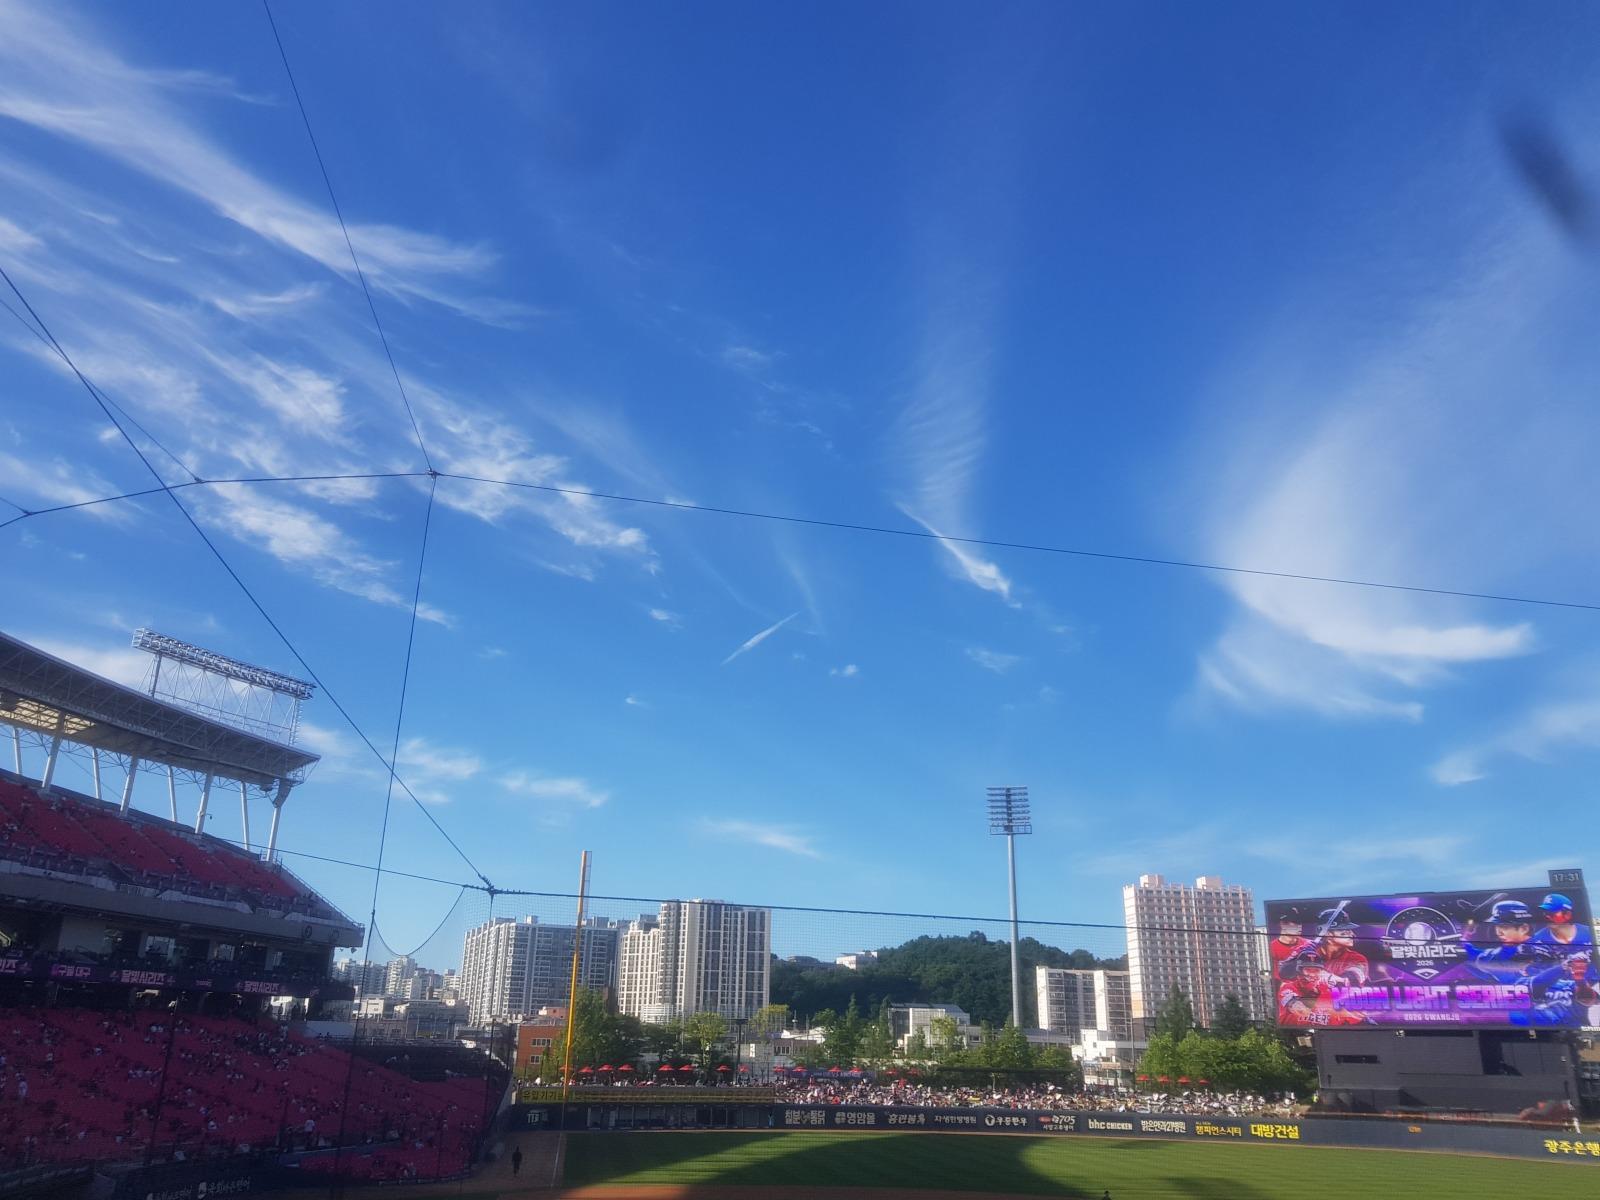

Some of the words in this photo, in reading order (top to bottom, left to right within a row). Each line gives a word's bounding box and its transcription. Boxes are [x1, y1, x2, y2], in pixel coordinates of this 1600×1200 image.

[1391, 944, 1458, 959] 달빛시리즈
[120, 970, 166, 985] 달빛시리즈
[1331, 986, 1390, 1010] MOON
[1393, 985, 1450, 1009] LIGHT
[1455, 984, 1531, 1009] SERIES
[1088, 1119, 1106, 1130] bhc
[1107, 1122, 1133, 1131] CHICKEN
[1195, 1125, 1242, 1137] 챔피언스시티
[1251, 1124, 1300, 1140] 대방건설
[1544, 1139, 1600, 1157] 광주은행
